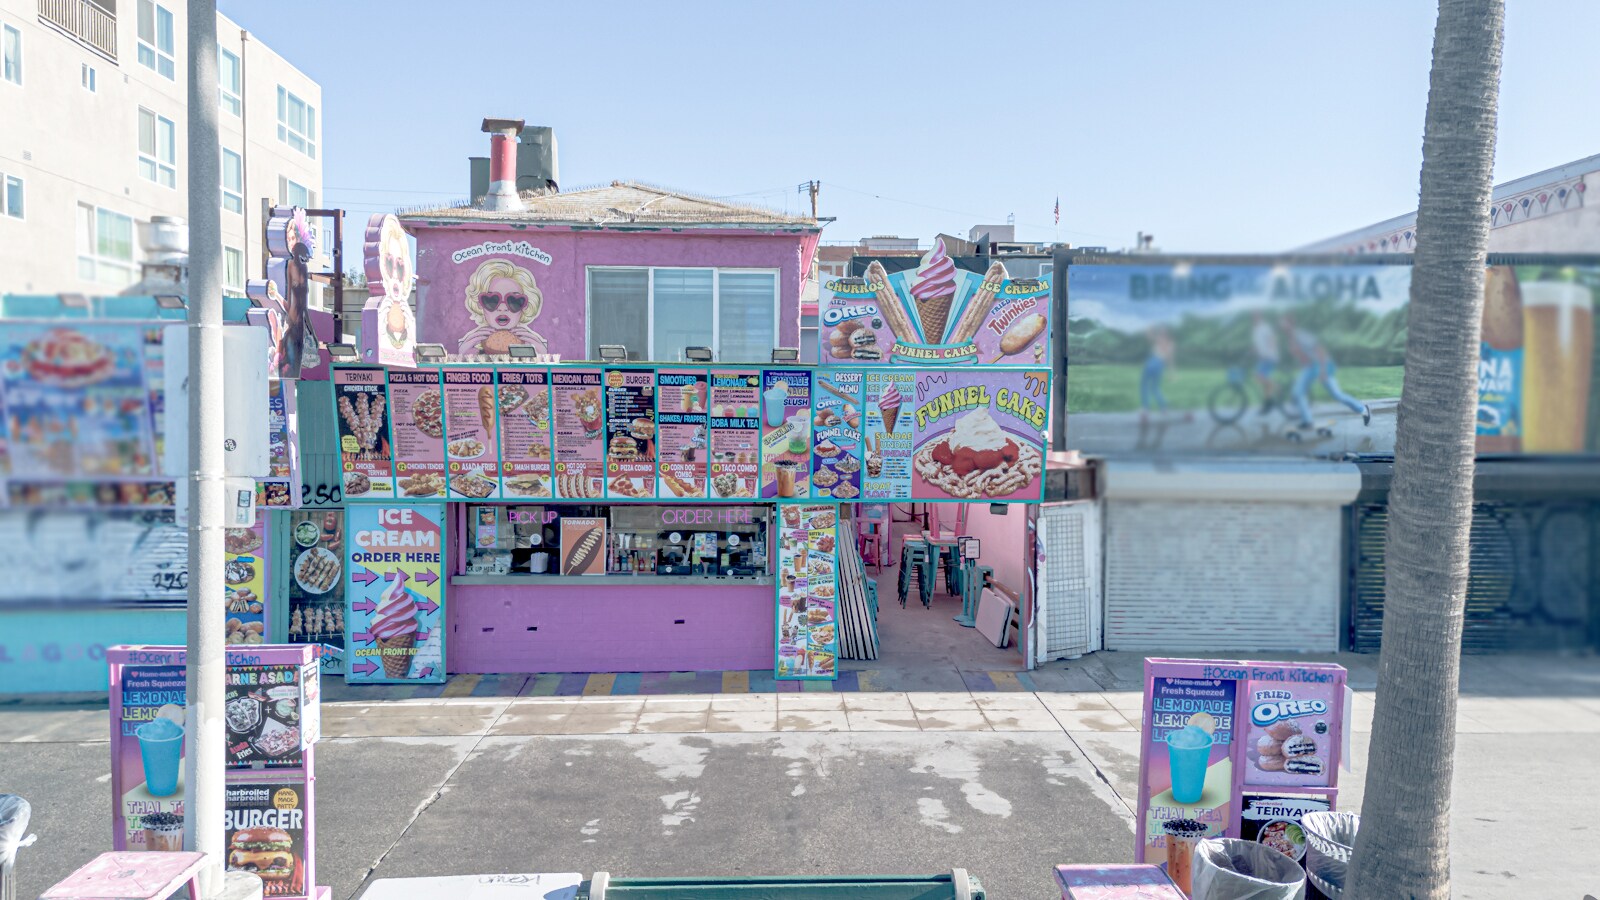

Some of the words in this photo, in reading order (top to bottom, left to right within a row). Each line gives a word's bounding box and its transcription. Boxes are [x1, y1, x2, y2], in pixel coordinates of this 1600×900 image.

[454, 246, 483, 262] Ocean
[485, 242, 512, 252] Front
[515, 243, 550, 263] Kitchen
[824, 280, 885, 294] CHURROS
[980, 280, 1001, 293] ICE
[1004, 280, 1049, 295] CREAM
[990, 298, 1011, 316] FRIED
[824, 305, 877, 326] OREO
[988, 297, 1036, 335] Twinkies
[891, 343, 939, 359] FUNNEL
[943, 344, 977, 358] CAKE
[345, 373, 373, 381] TERIYAKI
[389, 374, 406, 382] PIZZA
[413, 374, 425, 382] HOT
[426, 374, 439, 382] DOG
[446, 373, 471, 383] FINGER
[471, 373, 491, 383] FOOD
[502, 374, 523, 383] FRIES/
[525, 374, 543, 383] TOTS
[552, 374, 581, 384] MEXICAN
[583, 375, 601, 384] GRILL
[626, 376, 650, 384] BURGER
[659, 375, 697, 385] SMOOTHIES
[712, 377, 748, 387] LEMONADE
[835, 372, 862, 382] DESSERT
[866, 374, 879, 382] ICE
[882, 374, 914, 382] CREAM
[838, 384, 859, 393] MENU
[866, 384, 879, 392] ICE
[816, 400, 842, 410] OREO
[915, 385, 991, 431] FUNNEL
[996, 387, 1047, 431] CAKE
[659, 414, 683, 423] SHAKES/
[683, 415, 707, 423] FRAPPES
[711, 419, 728, 427] BOBA
[729, 419, 746, 427] MILK
[747, 419, 759, 428] TEA
[816, 428, 841, 441] FUNNEL
[844, 429, 862, 441] CAKE
[875, 432, 912, 440] SUNDAE
[880, 441, 912, 449] UNDAE
[737, 464, 757, 472] COMBO
[378, 508, 413, 525] ICE
[509, 511, 537, 524] PICK
[540, 511, 558, 524] UP
[661, 509, 713, 524] ORDER
[718, 509, 753, 524] HERE
[355, 530, 435, 547] CREAM
[351, 552, 402, 563] ORDER
[406, 552, 441, 563] HERE
[355, 649, 381, 657] OCEAN
[383, 648, 406, 656] FRONT
[225, 672, 258, 686] ARNE
[1203, 666, 1248, 679] #Ocean
[1252, 668, 1284, 681] Front
[1289, 668, 1334, 683] Kitchen
[151, 680, 186, 688] Squeeze
[1161, 687, 1183, 695] Fresh
[1185, 688, 1225, 697] Squeezed
[1256, 691, 1291, 700] FRIED
[1153, 698, 1232, 714] LEMONADE
[1252, 700, 1328, 727] OREO
[226, 788, 270, 797] harbroiled
[127, 800, 161, 814] THAI
[224, 808, 302, 830] BURGER
[1151, 807, 1184, 820] THAI
[1194, 808, 1222, 822] TEA
